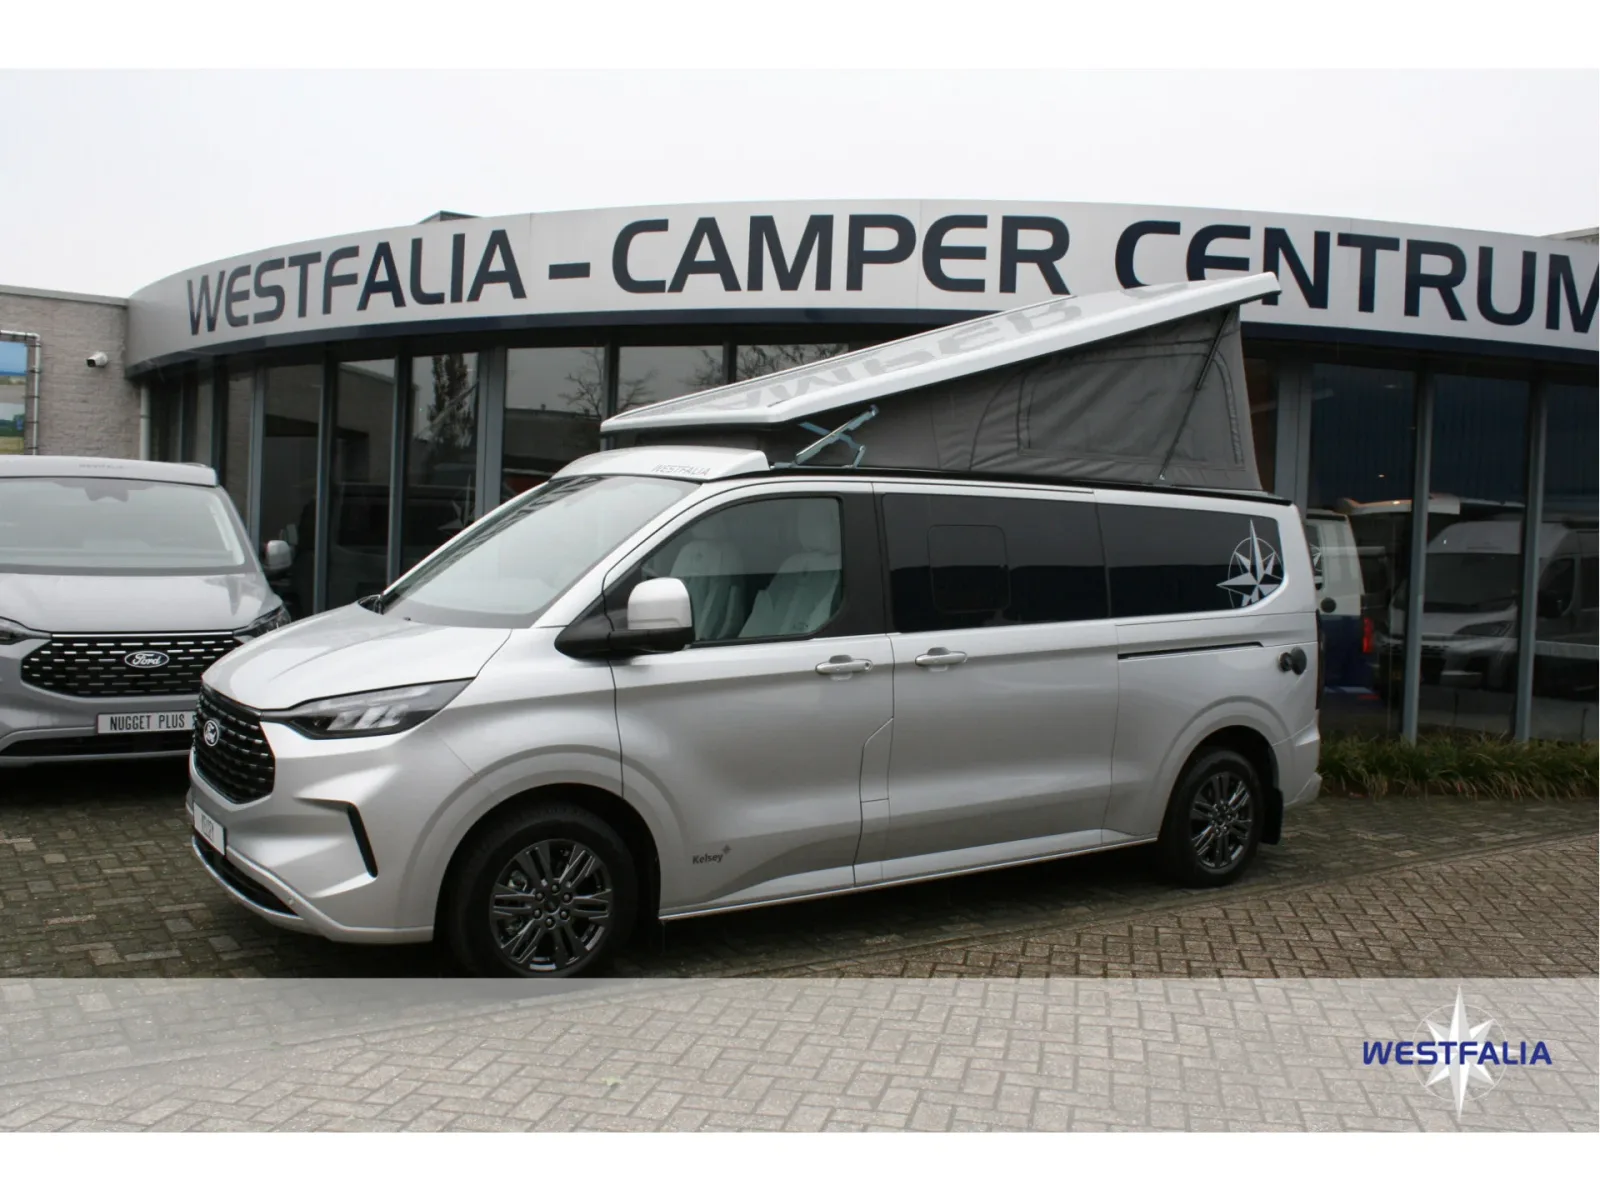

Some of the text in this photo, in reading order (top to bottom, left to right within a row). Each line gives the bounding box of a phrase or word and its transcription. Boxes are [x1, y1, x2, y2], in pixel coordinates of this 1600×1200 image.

[187, 229, 527, 336] WESTFALIA
[611, 213, 1071, 295] CAMPER
[1114, 220, 1599, 334] CENTRUM
[131, 653, 162, 665] Ford
[110, 715, 151, 731] NUGGET
[158, 713, 185, 729] PLUS
[692, 853, 723, 864] Kelsey
